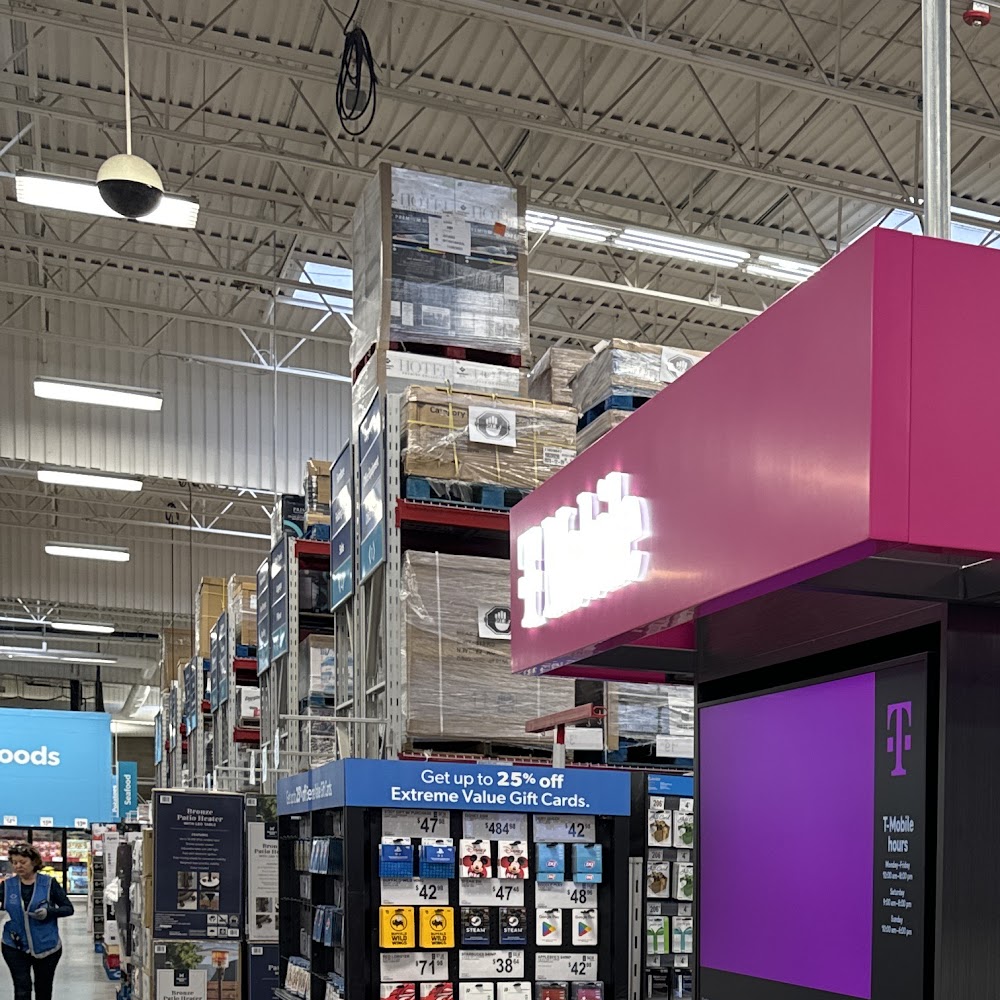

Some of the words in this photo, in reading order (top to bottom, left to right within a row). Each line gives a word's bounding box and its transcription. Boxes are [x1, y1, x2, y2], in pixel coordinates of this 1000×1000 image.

[887, 701, 912, 776] T
[0, 745, 60, 766] oods
[421, 769, 450, 785] Get
[453, 774, 474, 786] up
[478, 773, 493, 786] to
[497, 771, 536, 786] 25%
[539, 774, 564, 789] off
[124, 774, 132, 806] Seafood
[391, 787, 459, 802] Extreme
[462, 789, 507, 804] Value
[510, 791, 538, 806] Gift
[541, 792, 590, 808] Cards.
[198, 815, 224, 823] Heater
[883, 815, 915, 833] T-Mobile
[887, 836, 909, 853] hours
